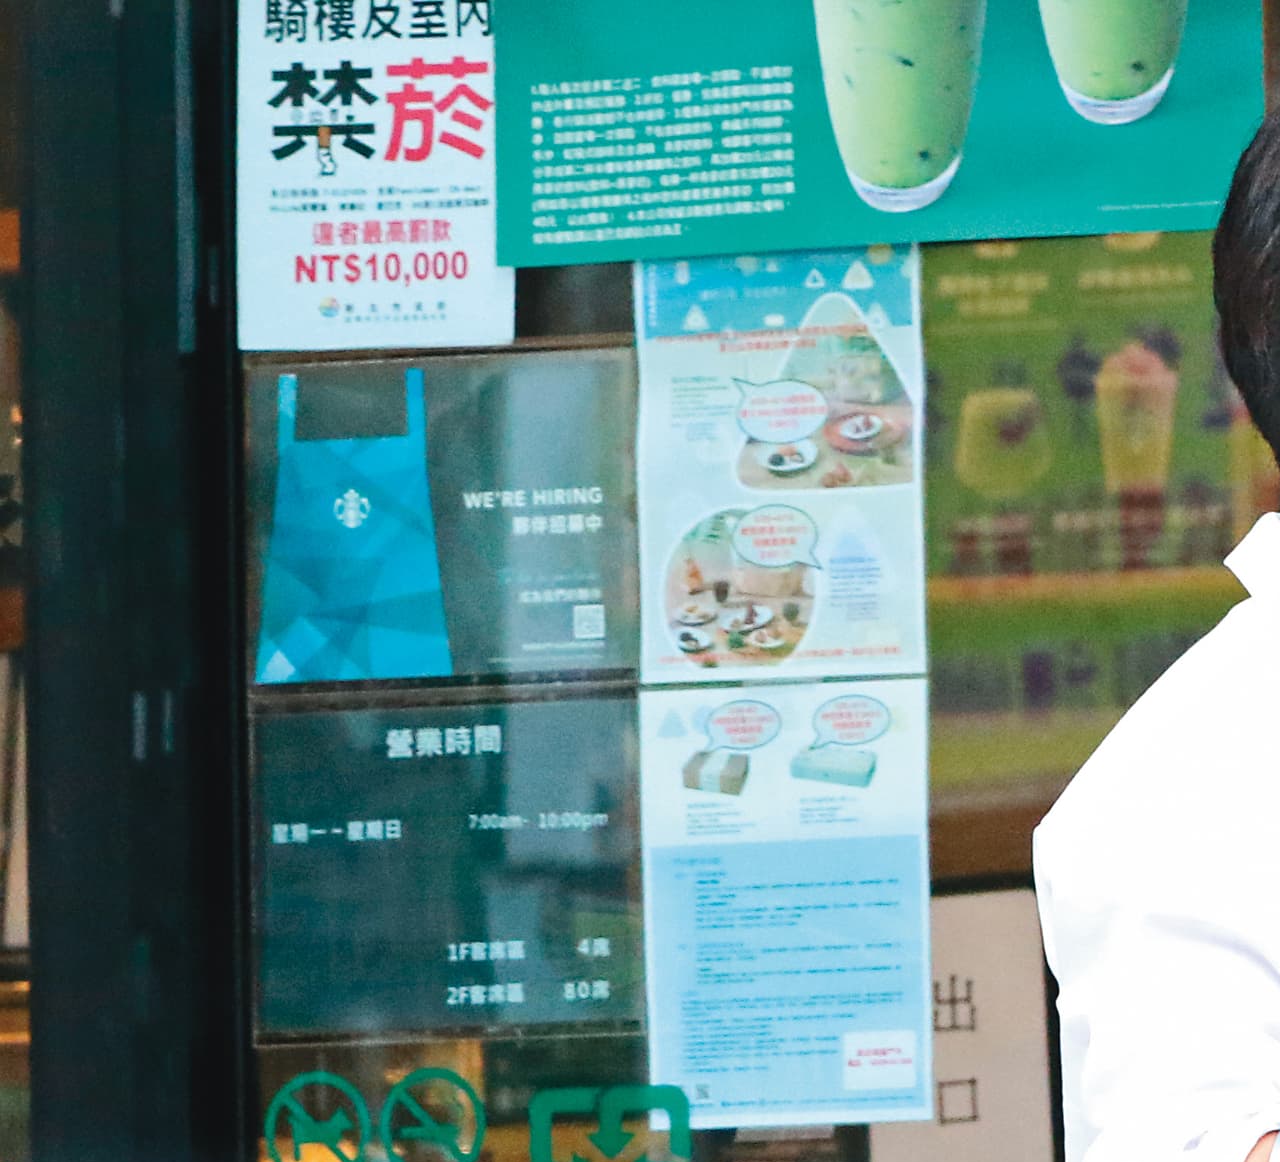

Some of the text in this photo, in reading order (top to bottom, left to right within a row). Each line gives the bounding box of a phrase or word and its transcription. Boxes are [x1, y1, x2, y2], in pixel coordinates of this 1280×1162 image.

[268, 57, 494, 162] 禁菸
[294, 251, 468, 287] NT$10,000
[463, 487, 603, 510] WE'RE HIRING
[386, 725, 501, 758] 營業時間
